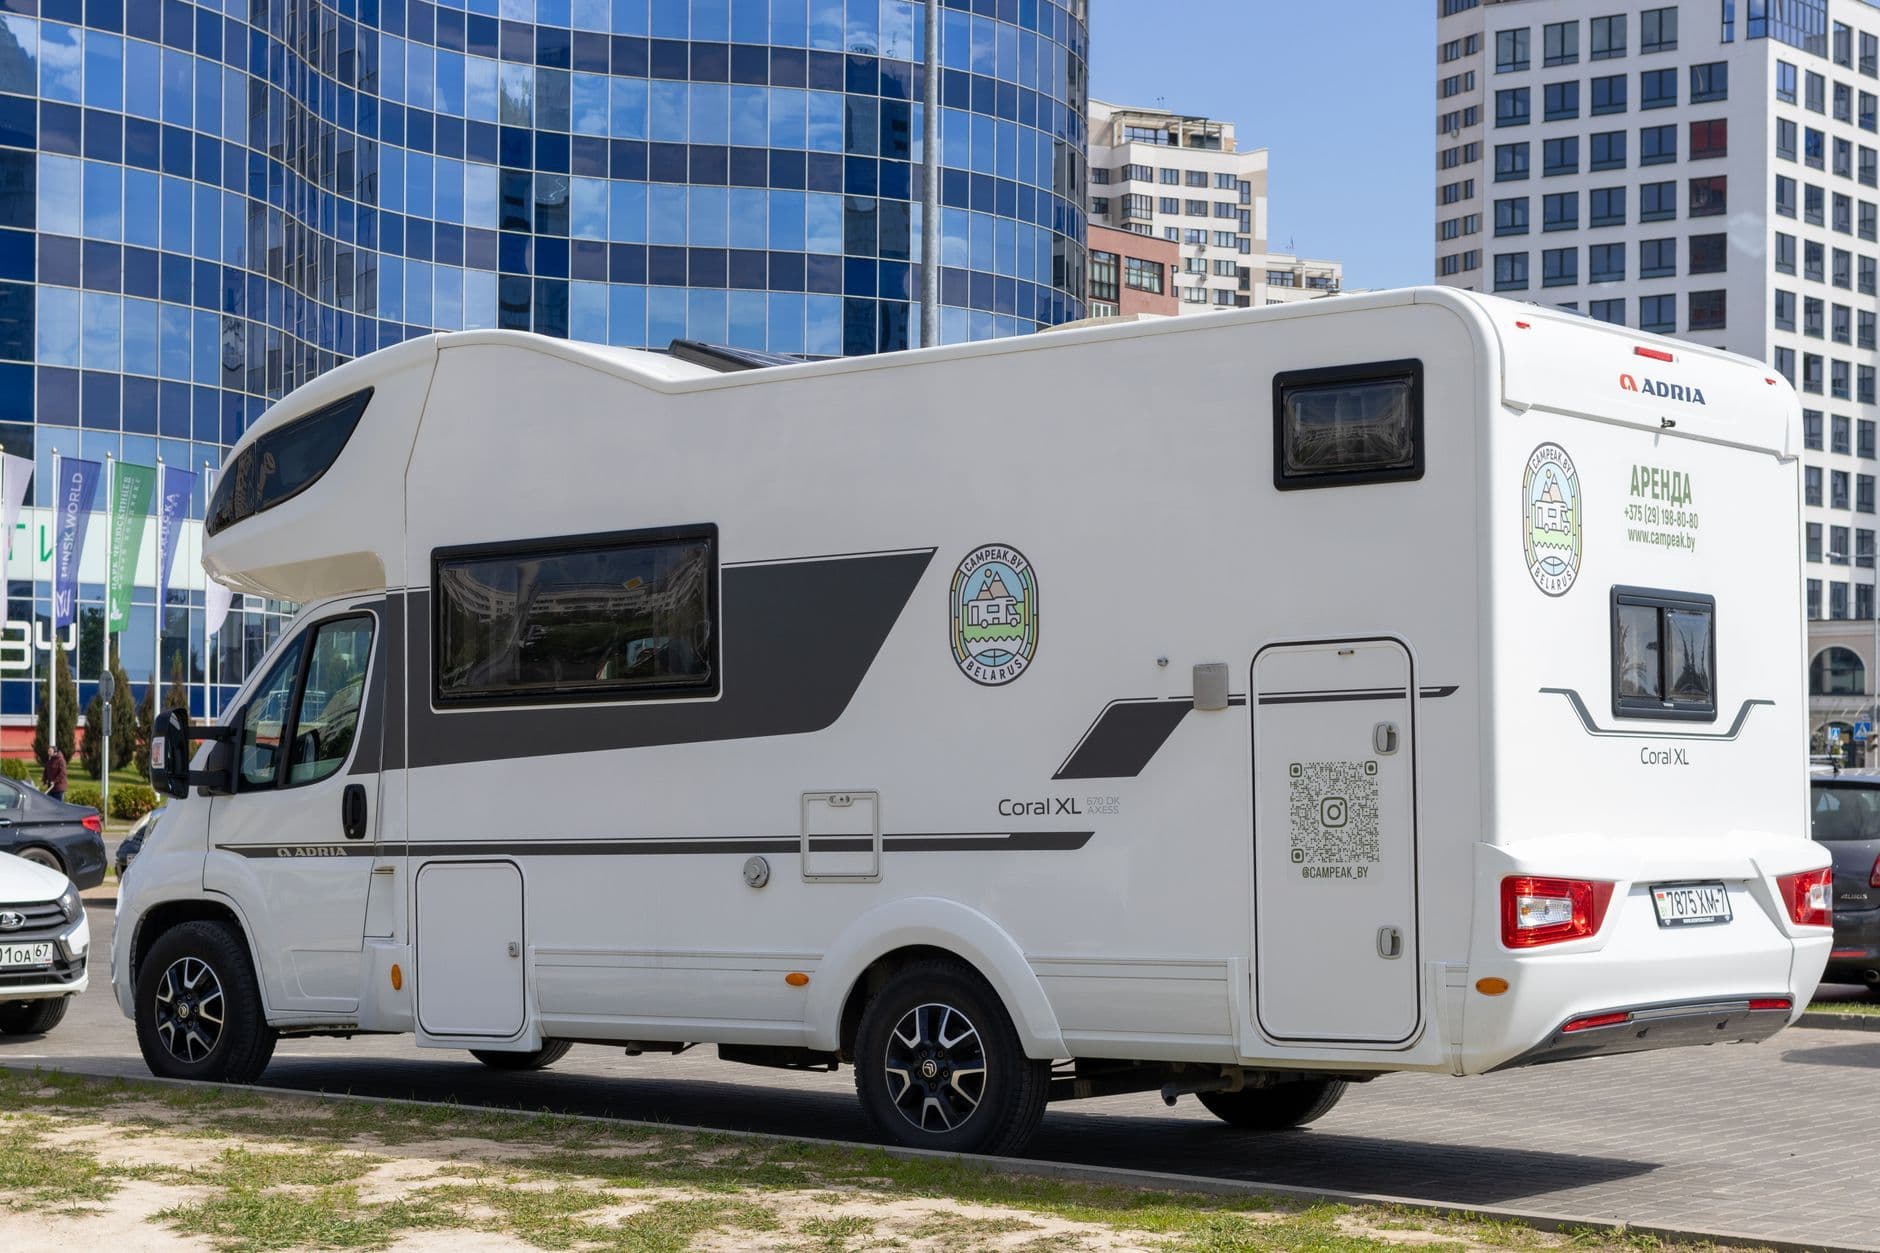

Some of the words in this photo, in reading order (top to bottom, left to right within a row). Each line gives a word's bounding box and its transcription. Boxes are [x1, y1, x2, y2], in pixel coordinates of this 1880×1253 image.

[1641, 378, 1706, 405] ADRIA
[1532, 448, 1572, 474] CAMPEAK.BY
[1630, 464, 1692, 508] АРЕНДА
[67, 473, 83, 530] WORLD
[1624, 504, 1642, 521] +375
[1644, 504, 1660, 526] (29)
[1661, 508, 1699, 529] 198-80-80
[1627, 528, 1696, 553] www.campeak.by
[964, 549, 1024, 573] CAMPEAK.BY
[1534, 566, 1572, 591] BELARUS
[966, 658, 1023, 681] BELARUS
[1641, 747, 1671, 765] Coral
[1674, 748, 1690, 765] XL
[998, 797, 1050, 816] Coral
[1055, 797, 1082, 815] XL
[295, 847, 348, 857] ADRIA
[1302, 866, 1369, 880] @CAMPEAK_BY
[1666, 890, 1698, 916] 7875
[35, 944, 49, 957] 67
